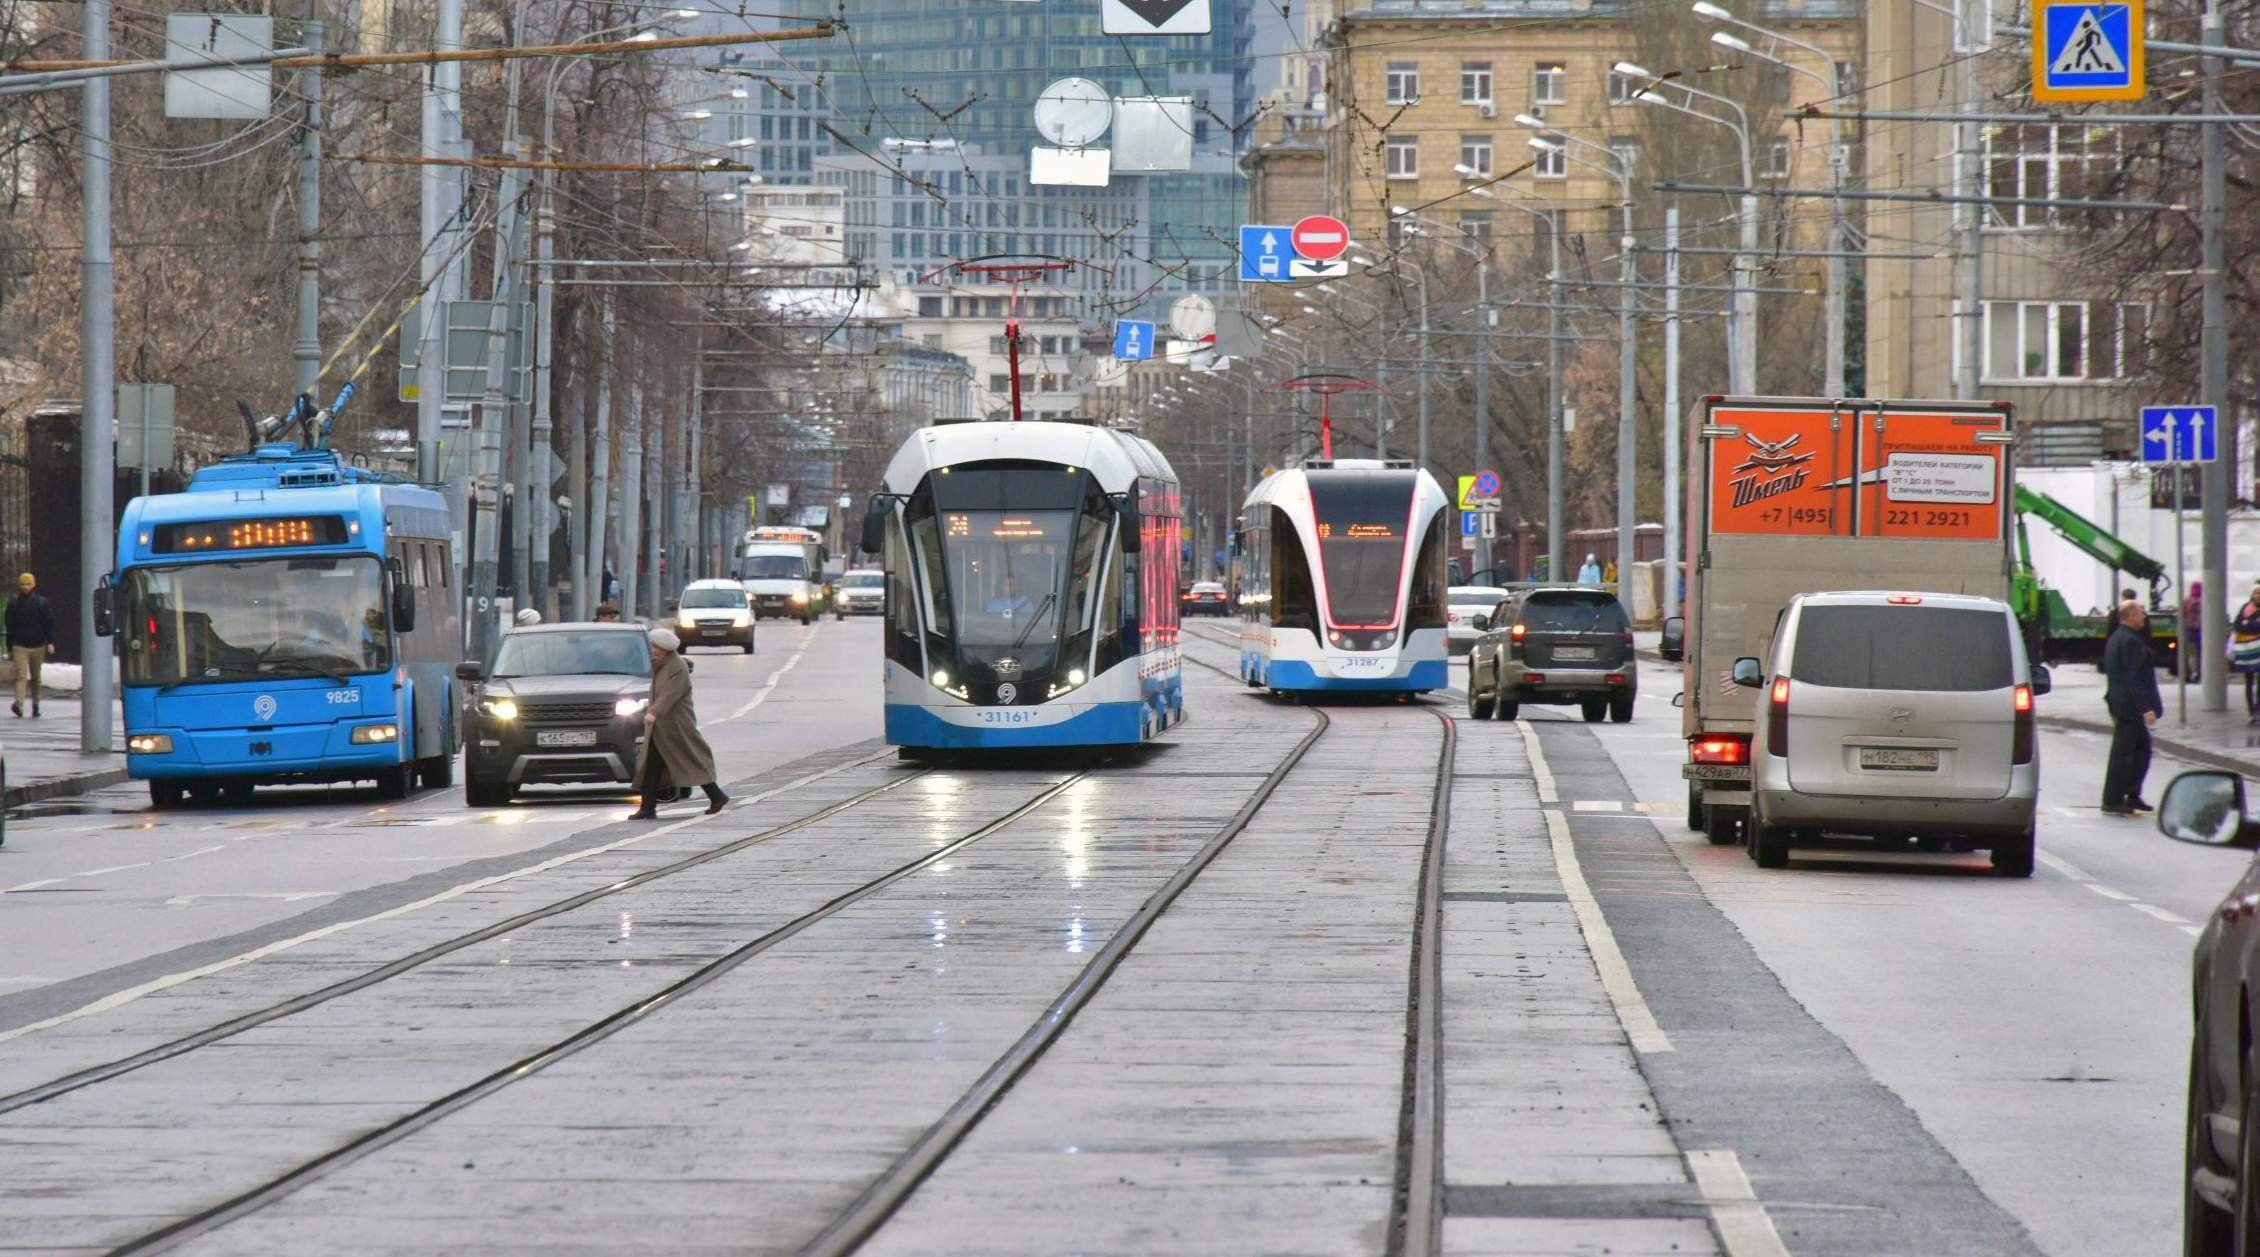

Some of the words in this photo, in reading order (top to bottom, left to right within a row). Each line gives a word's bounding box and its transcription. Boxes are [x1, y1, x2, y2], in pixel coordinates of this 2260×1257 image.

[1947, 443, 1959, 451] НА
[1892, 460, 1937, 469] ВОДИТЕЛЕЙ
[1940, 461, 1984, 470] КАТЕГОРИИ
[1728, 466, 1811, 508] Шмель
[1935, 489, 1990, 497] ТРАНСПОРТОМ
[1760, 508, 1783, 522] +7
[1887, 510, 1919, 525] 221
[1926, 511, 1970, 526] 2921
[478, 596, 489, 612] 9
[1346, 657, 1378, 666] 31287
[326, 690, 360, 704] 9825
[985, 712, 1029, 722] 31161
